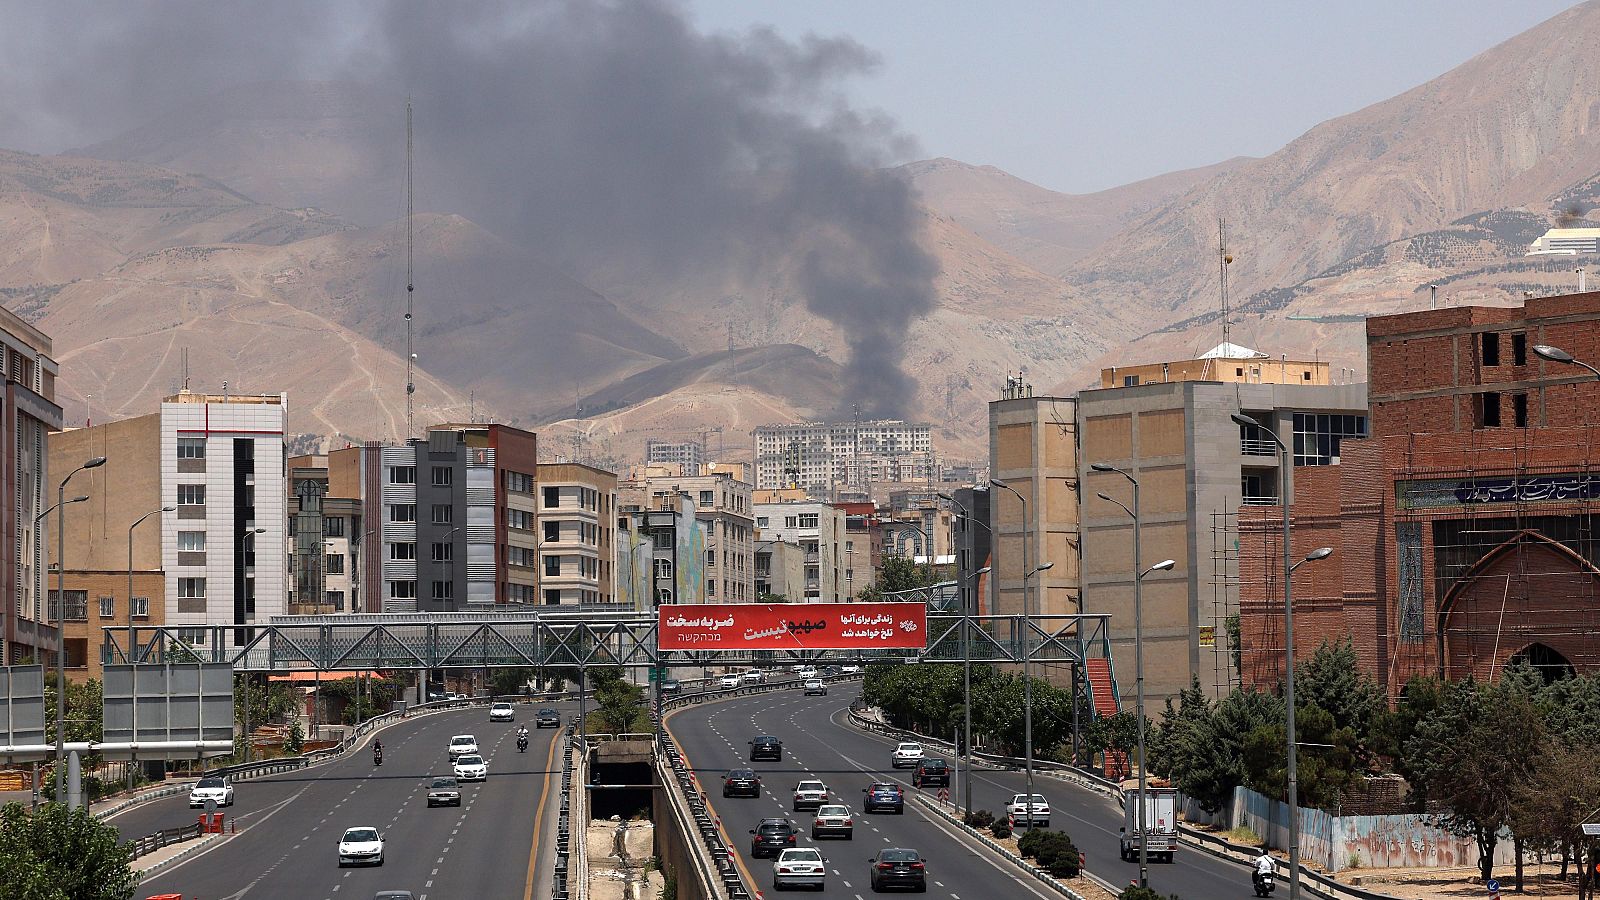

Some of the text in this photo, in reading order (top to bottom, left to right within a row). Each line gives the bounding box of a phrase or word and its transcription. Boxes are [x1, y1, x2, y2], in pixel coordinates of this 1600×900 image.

[667, 613, 735, 630] ضربه سخت
[840, 613, 893, 624] زندگی برای آنها
[841, 628, 893, 639] تلخ خواهد شد
